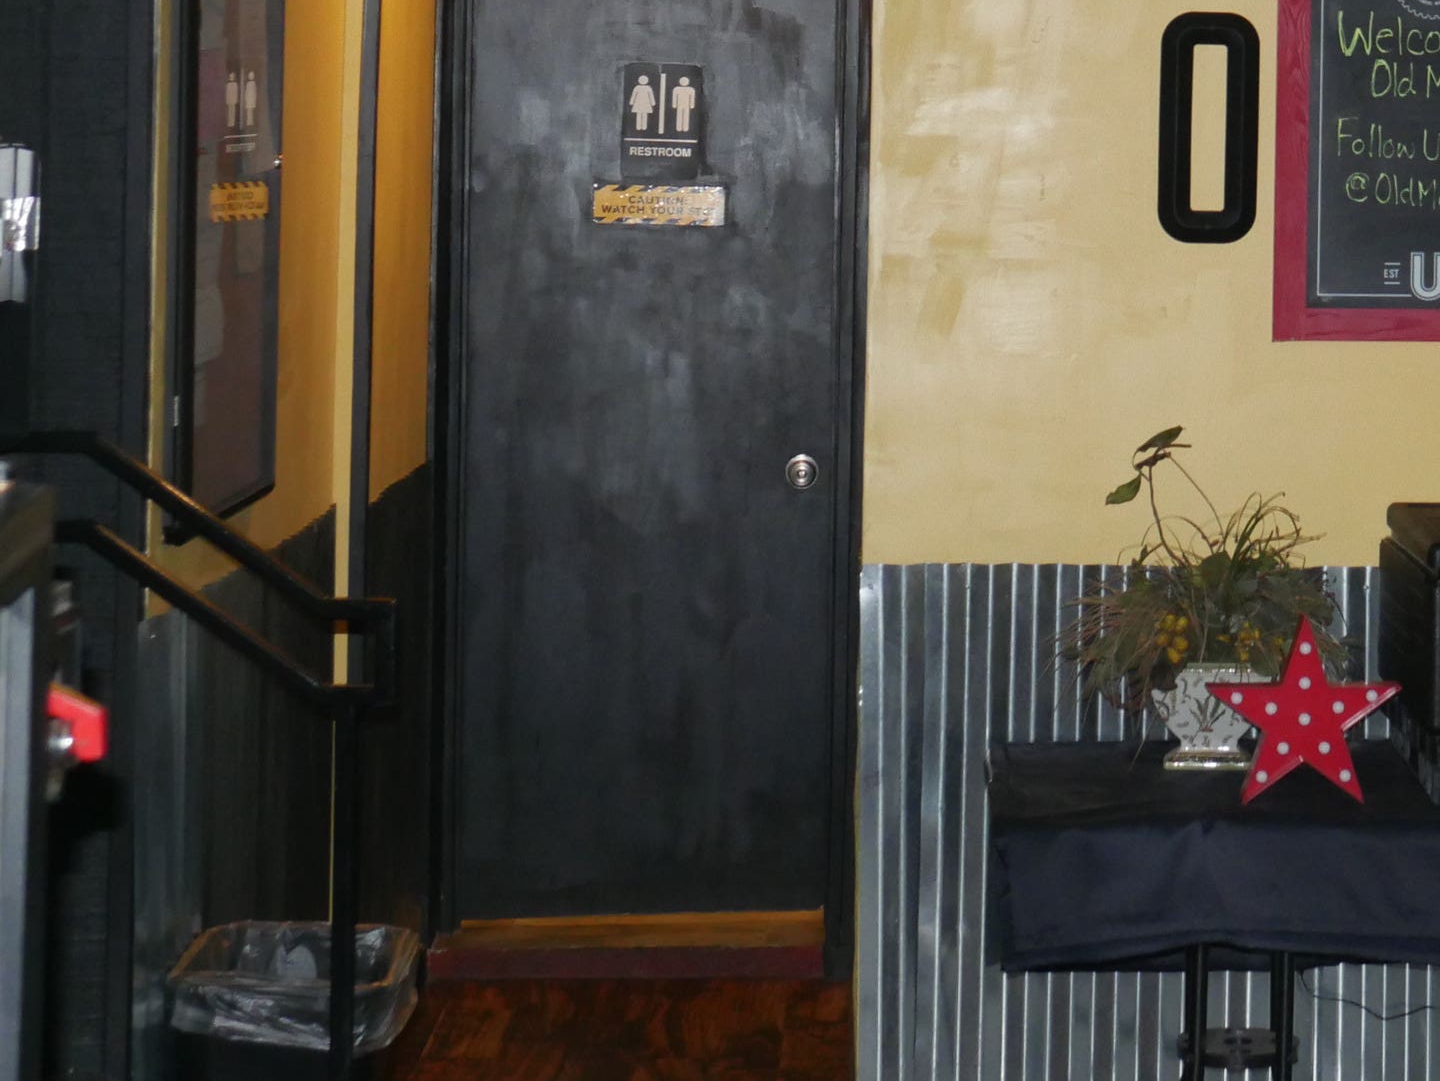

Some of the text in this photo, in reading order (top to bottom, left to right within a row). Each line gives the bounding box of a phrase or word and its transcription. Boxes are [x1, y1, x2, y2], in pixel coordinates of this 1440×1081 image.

[1371, 58, 1417, 98] Old
[1157, 11, 1260, 244] O
[1336, 116, 1416, 160] Follow
[628, 146, 692, 158] RESTROOM
[601, 204, 645, 215] WATCH
[1383, 268, 1400, 279] EST
